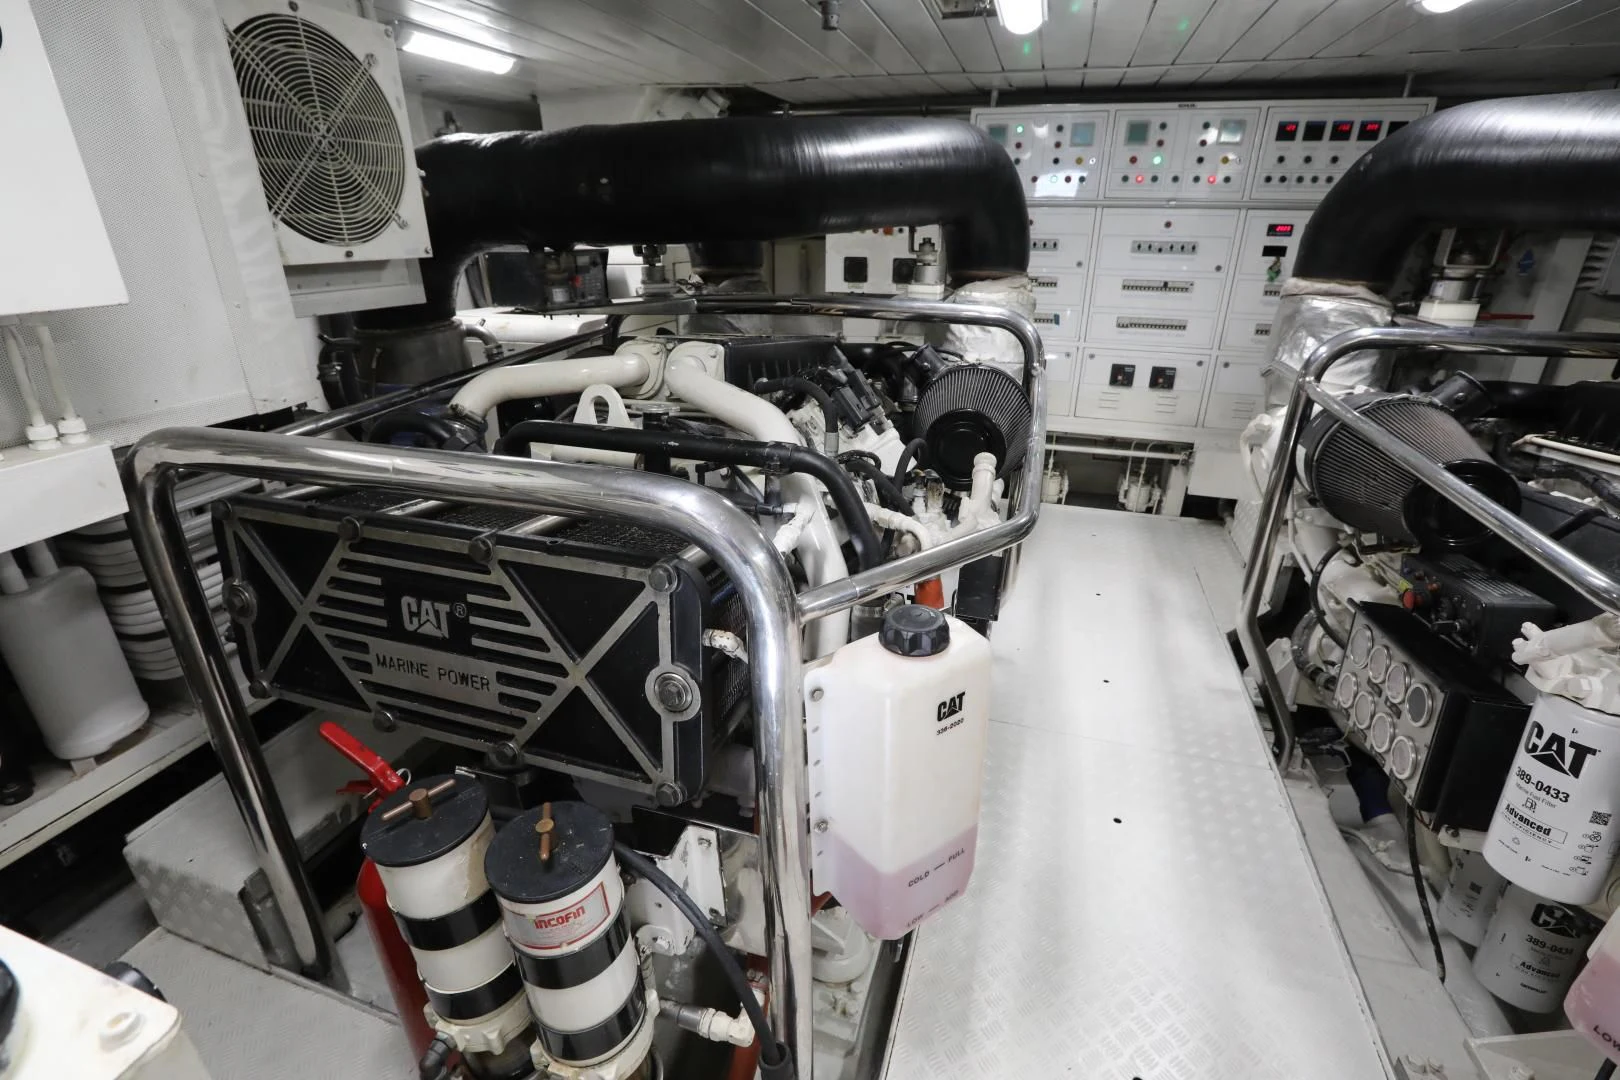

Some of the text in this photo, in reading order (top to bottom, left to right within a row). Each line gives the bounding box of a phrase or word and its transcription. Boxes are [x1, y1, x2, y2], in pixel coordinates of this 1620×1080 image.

[376, 653, 490, 692] MARINE POWER
[937, 691, 966, 722] CAT
[1524, 720, 1598, 779] CAT
[1515, 766, 1571, 803] 389-0433
[1504, 803, 1552, 836] Advanced
[908, 847, 965, 888] COLD FULL
